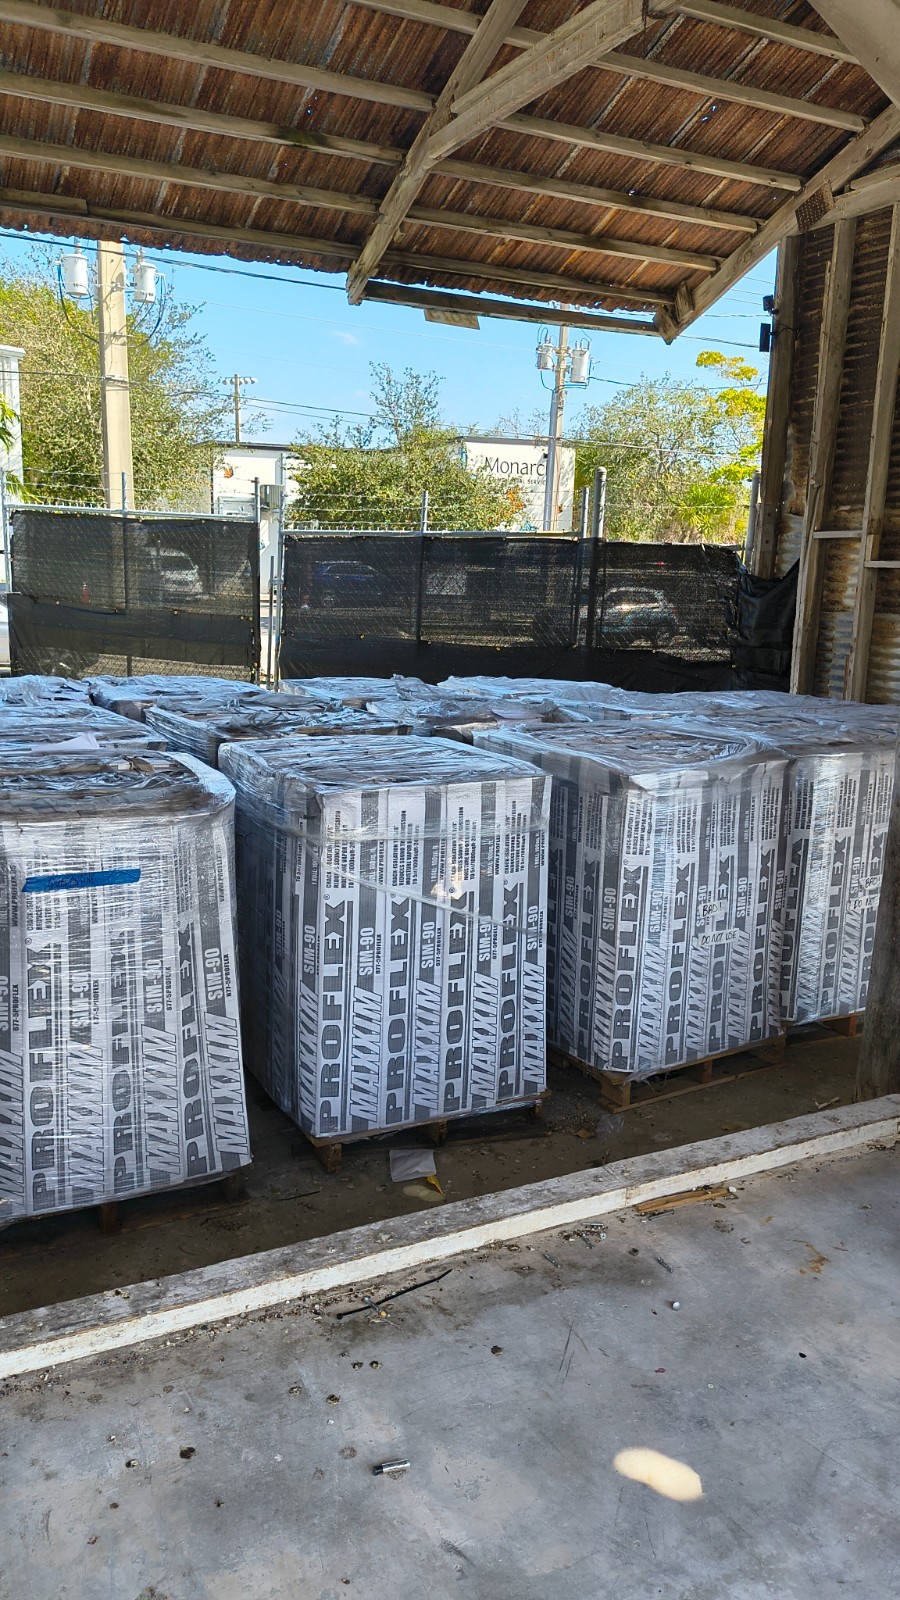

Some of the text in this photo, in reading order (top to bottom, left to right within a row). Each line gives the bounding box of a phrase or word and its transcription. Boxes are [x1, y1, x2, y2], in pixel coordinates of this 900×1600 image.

[485, 456, 545, 477] Monarc
[526, 905, 539, 951] SIM-90
[564, 876, 575, 917] SIM-90
[602, 887, 617, 931] SIM-90
[649, 890, 664, 933] SIM-90
[736, 877, 748, 918] SIM-90
[774, 870, 785, 910] SIM-90
[820, 836, 847, 1015] PROFLEX
[850, 856, 861, 894] SIM-90
[144, 959, 163, 1014] SIM-90
[204, 947, 224, 1001] SIM-90
[303, 925, 316, 975] SIM-90
[359, 927, 374, 976] SIM-90
[420, 921, 435, 969] SIM-90
[478, 915, 491, 962] SIM-90
[498, 883, 519, 1100] PROFLEX
[578, 859, 596, 1062] PROFLEX
[593, 936, 617, 1062] MAXXIM
[611, 866, 641, 1070] PROFLEX
[664, 863, 690, 1066] PROFLEX
[685, 936, 711, 1052] MAXXIM
[701, 935, 711, 945] DO
[711, 933, 723, 943] NOT
[726, 929, 750, 1040] MAXXIM
[749, 849, 771, 1042] PROFLEX
[767, 918, 785, 1028] MAXXIM
[838, 902, 862, 1006] MAXXIM
[71, 972, 91, 1028] SIM-90
[177, 921, 208, 1178] PROFLEX
[299, 979, 319, 1126] MAXXIM
[319, 900, 345, 1134] PROFLEX
[349, 985, 383, 1123] MAXXIM
[385, 897, 410, 1125] PROFLEX
[412, 978, 442, 1110] MAXXIM
[443, 891, 468, 1113] PROFLEX
[470, 971, 499, 1099] MAXXIM
[522, 960, 545, 1085] MAXXIM
[637, 939, 666, 1061] MAXXIM
[27, 943, 56, 1211] PROFLEX
[65, 1039, 105, 1194] MAXXIM
[140, 1022, 181, 1176] MAXXIM
[203, 1011, 249, 1156] MAXXIM
